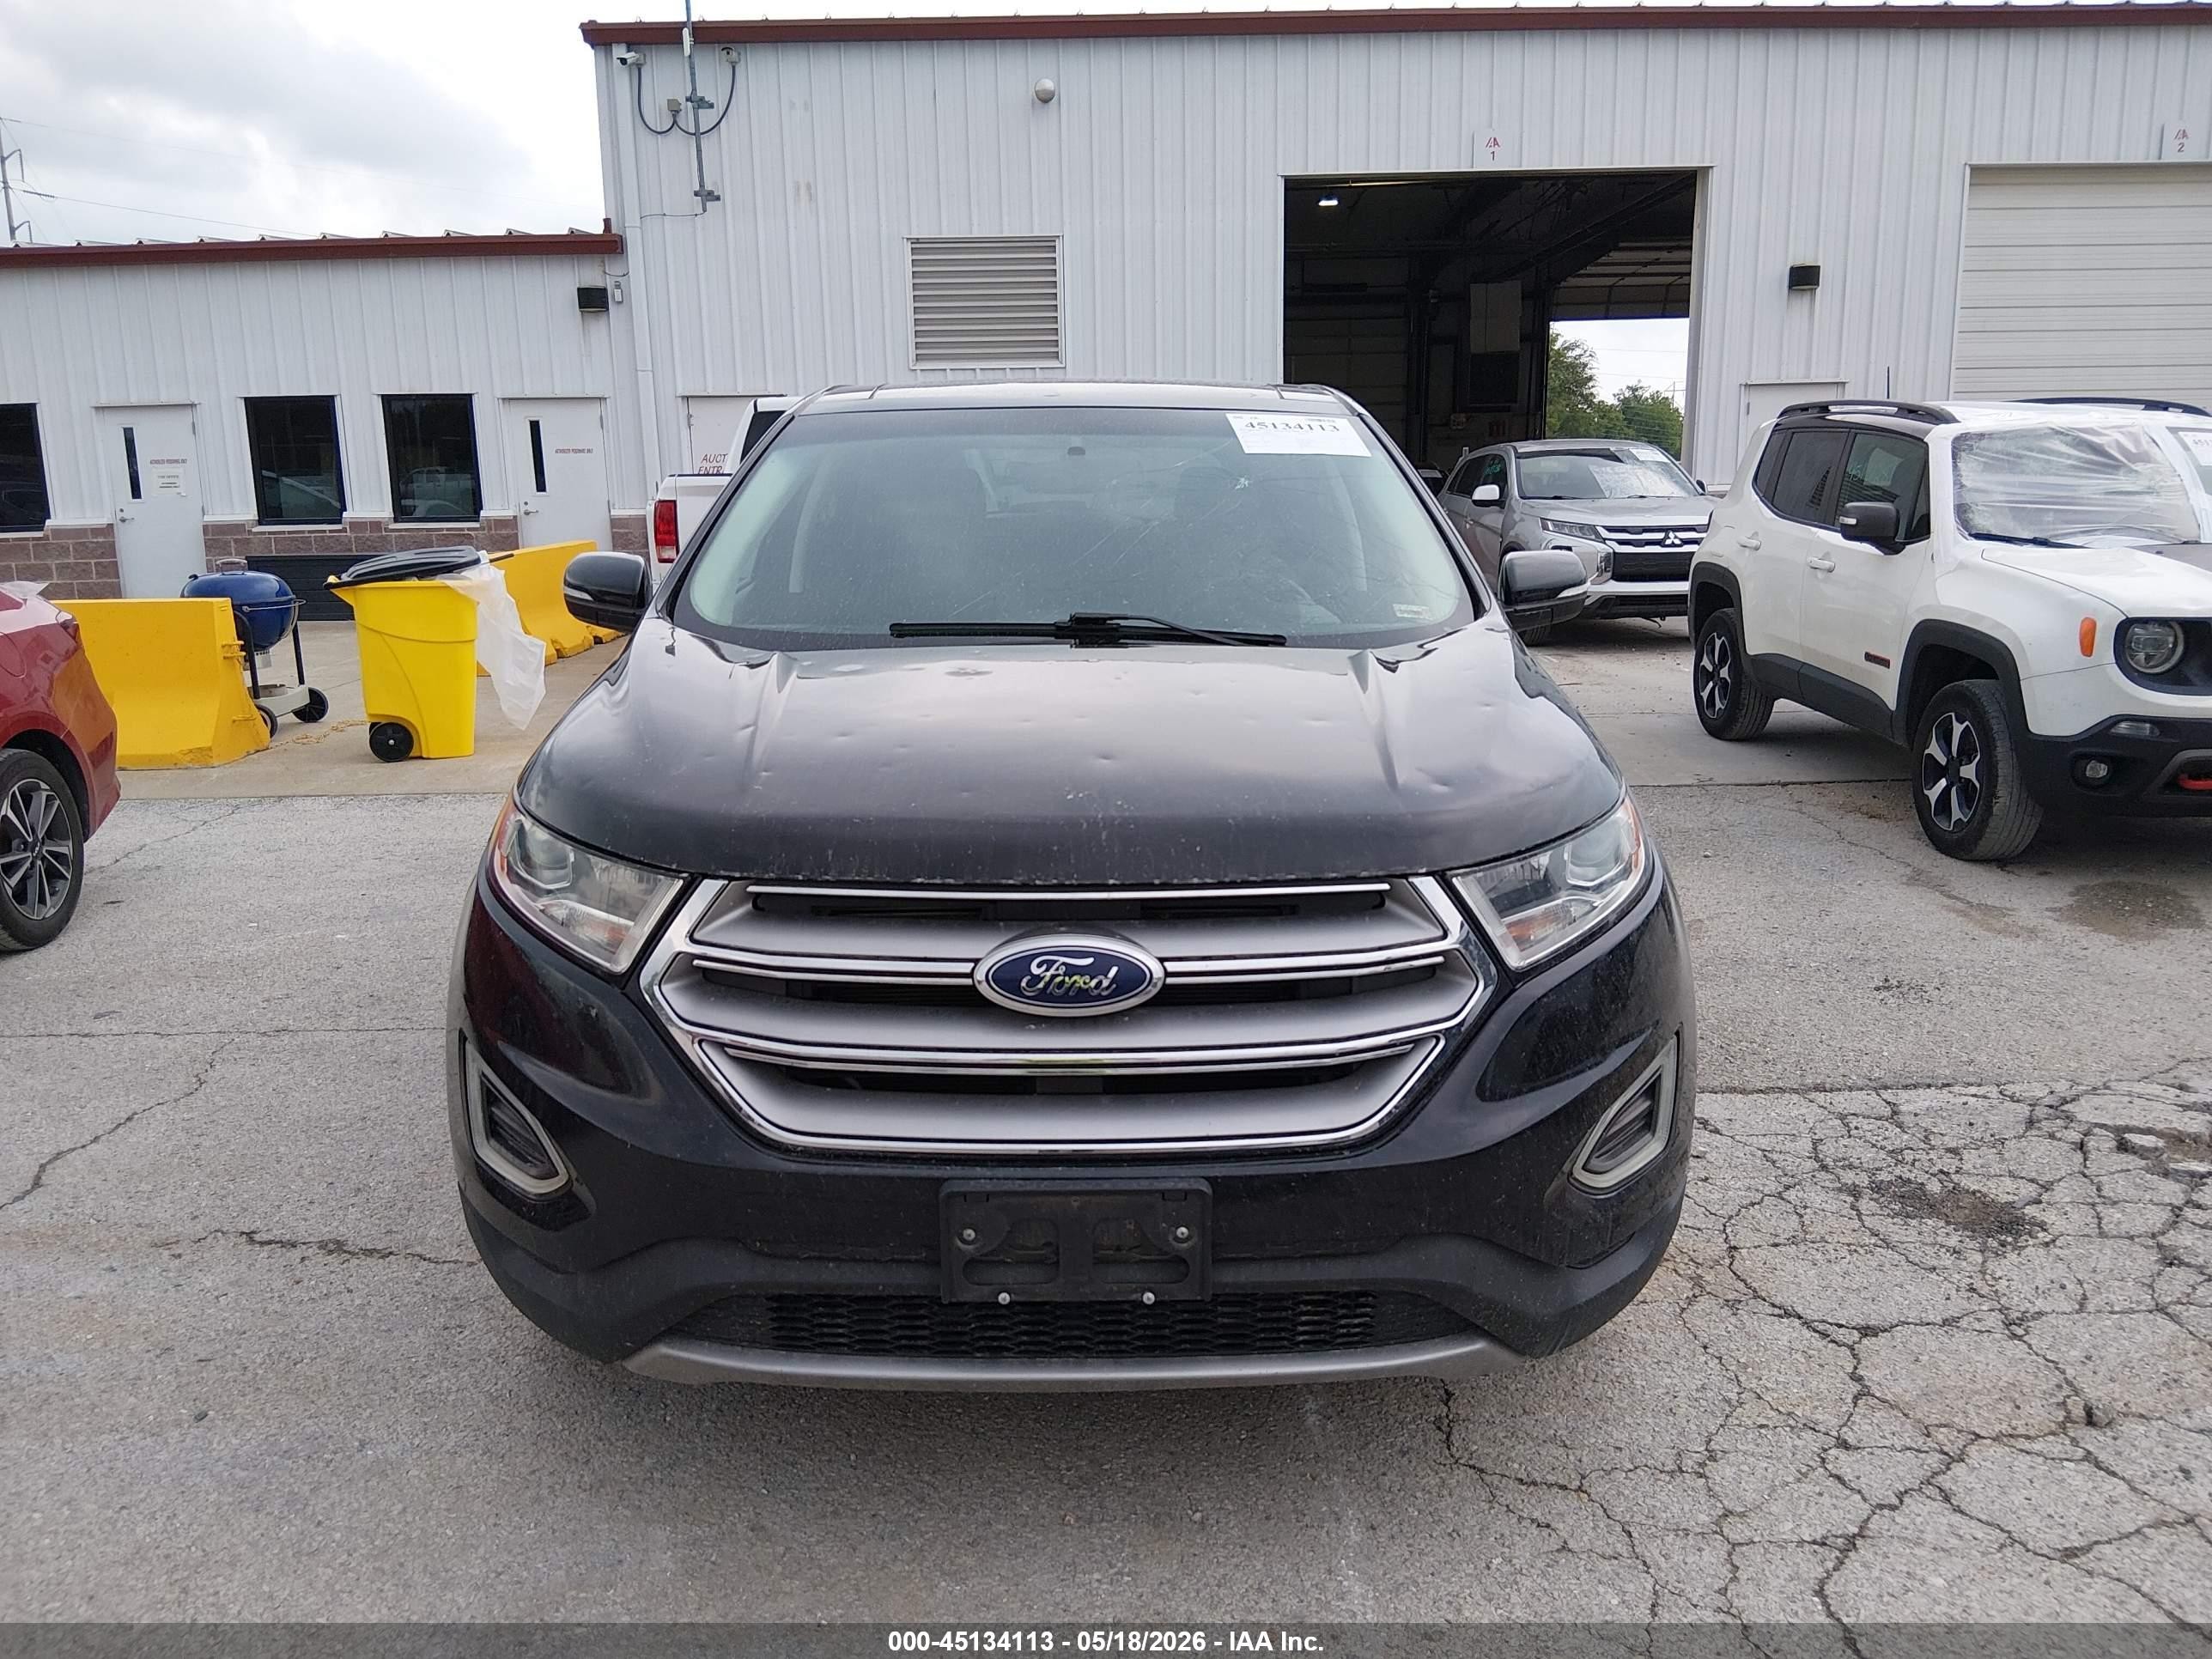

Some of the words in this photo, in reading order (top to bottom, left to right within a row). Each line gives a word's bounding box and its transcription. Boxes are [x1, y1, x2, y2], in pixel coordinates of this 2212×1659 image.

[2178, 143, 2185, 153] 2
[1490, 150, 1495, 161] 1
[701, 453, 729, 465] AUCT
[697, 465, 726, 474] ENTR
[1020, 955, 1119, 996] Ford
